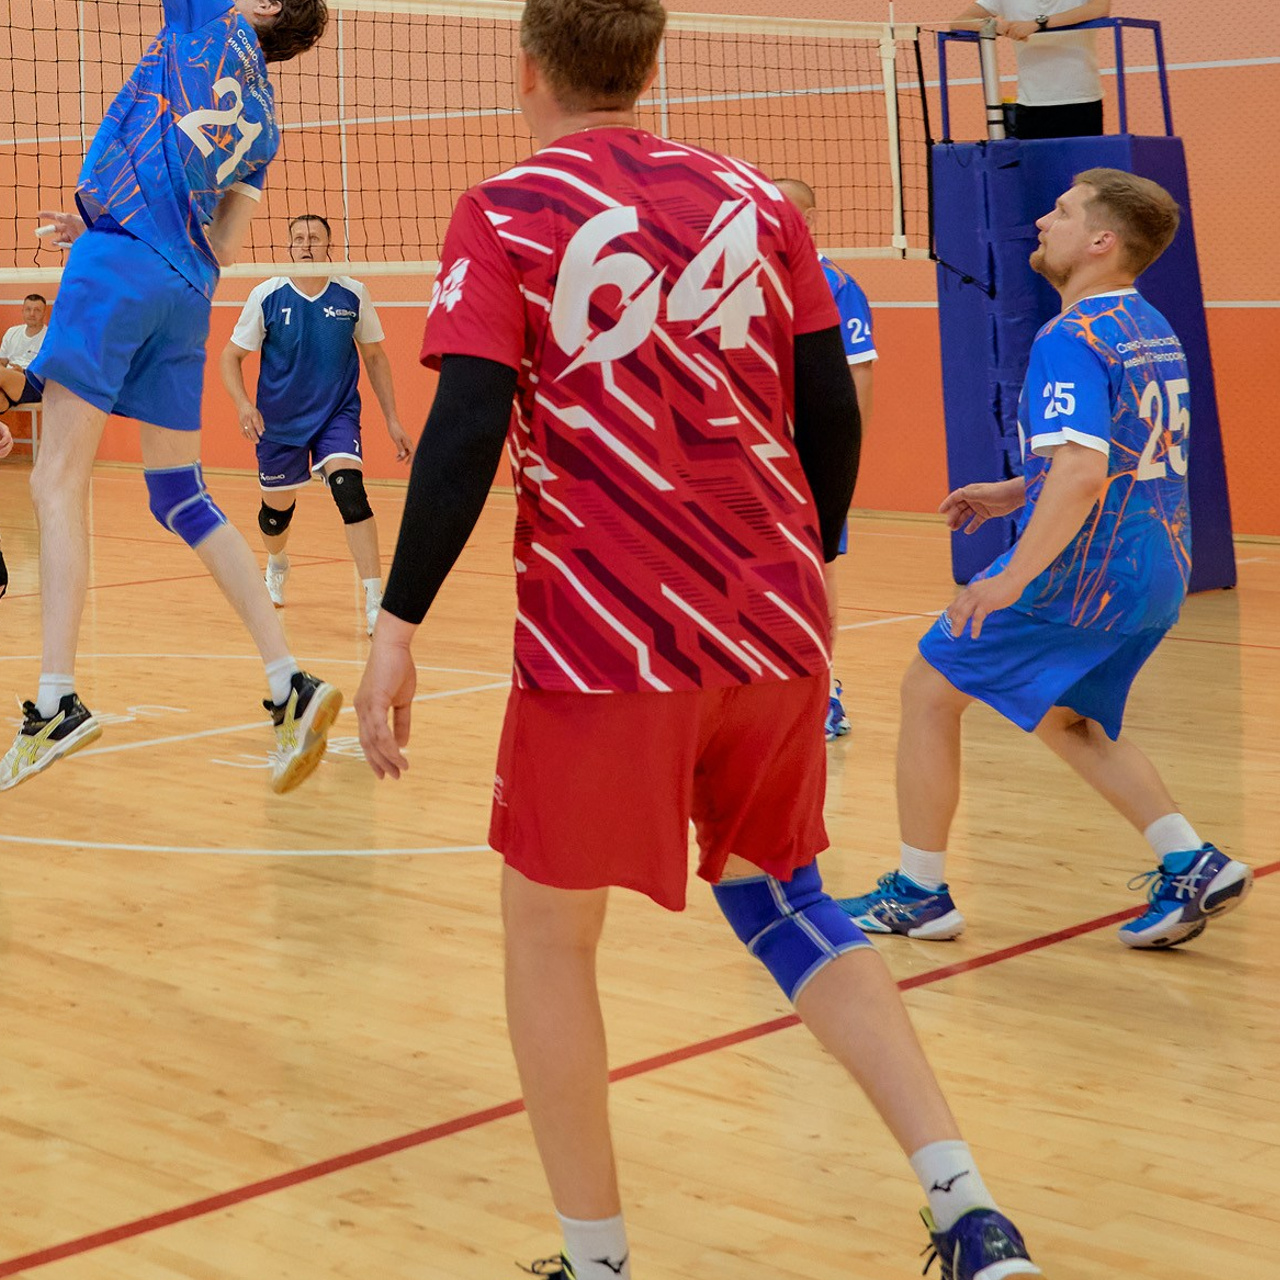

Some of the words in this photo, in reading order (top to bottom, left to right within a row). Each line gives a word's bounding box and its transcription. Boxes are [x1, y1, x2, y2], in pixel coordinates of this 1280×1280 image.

[176, 76, 263, 186] 21
[281, 307, 292, 325] 7
[549, 194, 768, 384] 64
[1042, 381, 1076, 420] 25
[1136, 378, 1191, 481] 25
